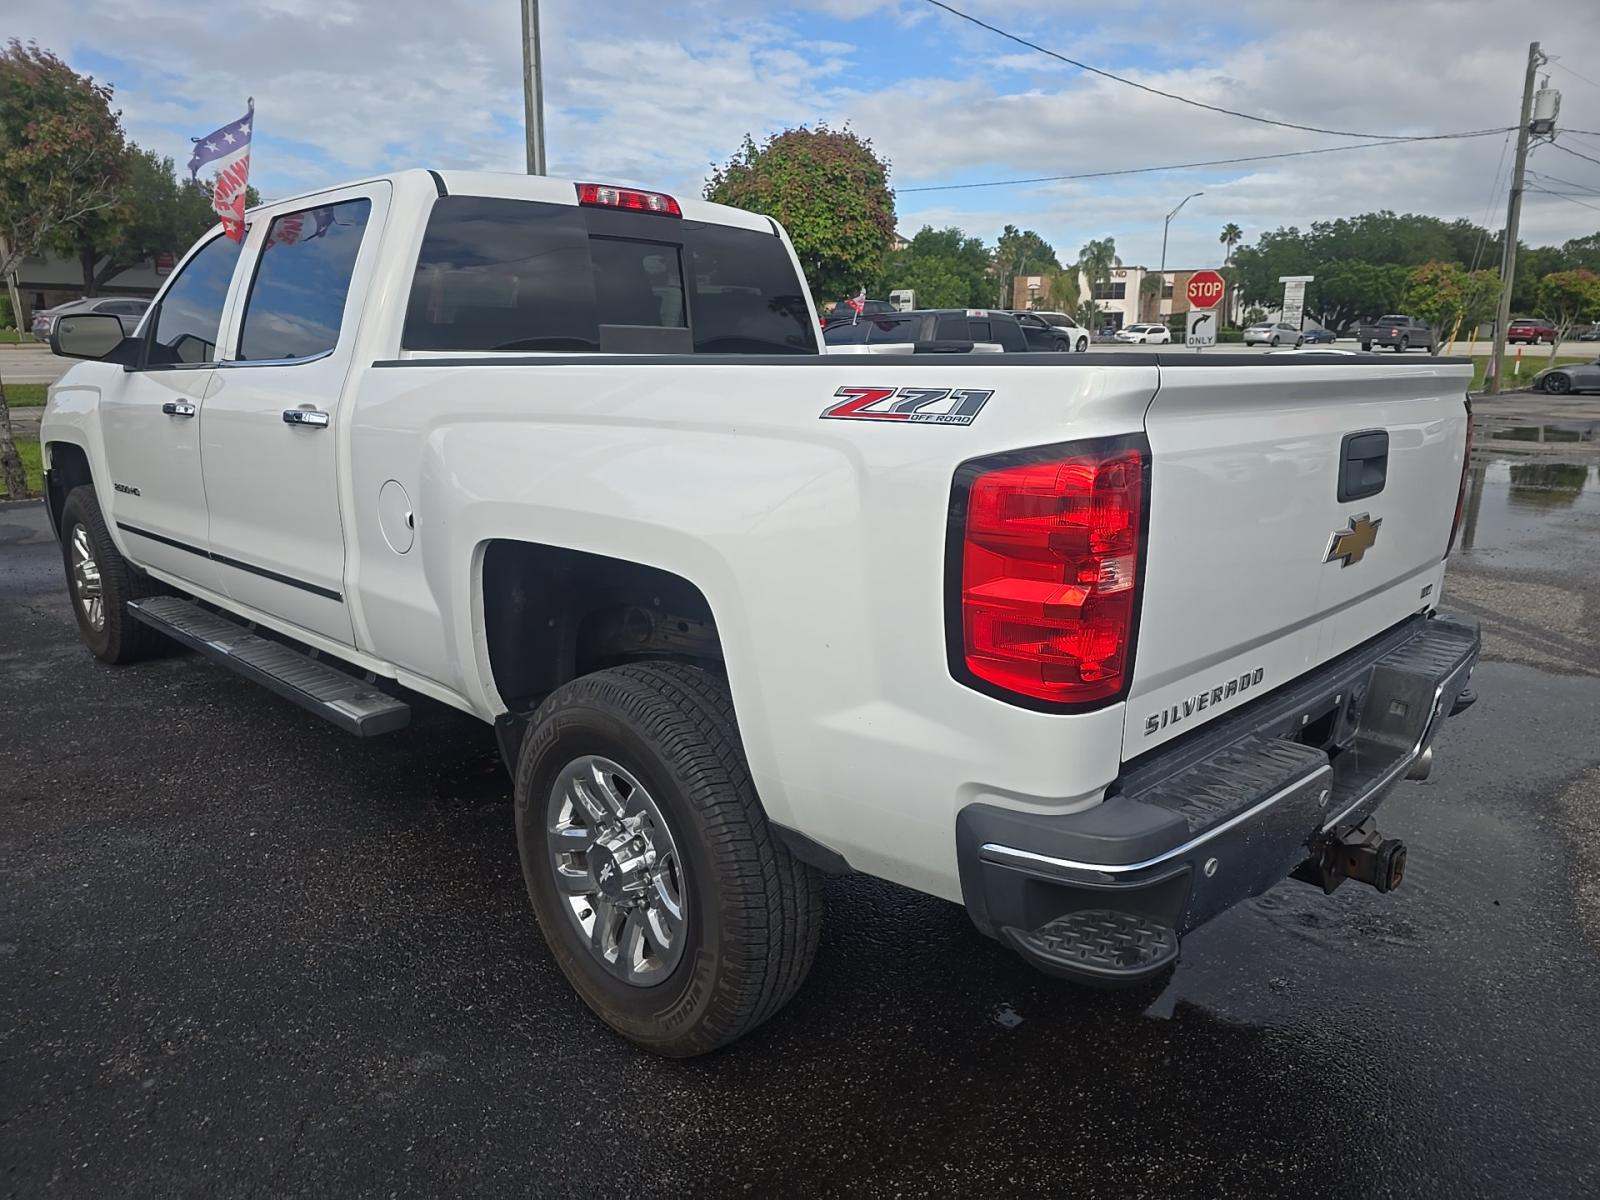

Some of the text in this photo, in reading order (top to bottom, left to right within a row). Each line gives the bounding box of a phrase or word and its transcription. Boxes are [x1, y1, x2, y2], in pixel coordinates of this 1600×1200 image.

[1189, 282, 1221, 297] STOP
[1189, 335, 1214, 345] ONLY
[819, 385, 995, 426] Z71
[911, 414, 971, 423] OFF ROAD
[1144, 667, 1264, 737] SILVERADO
